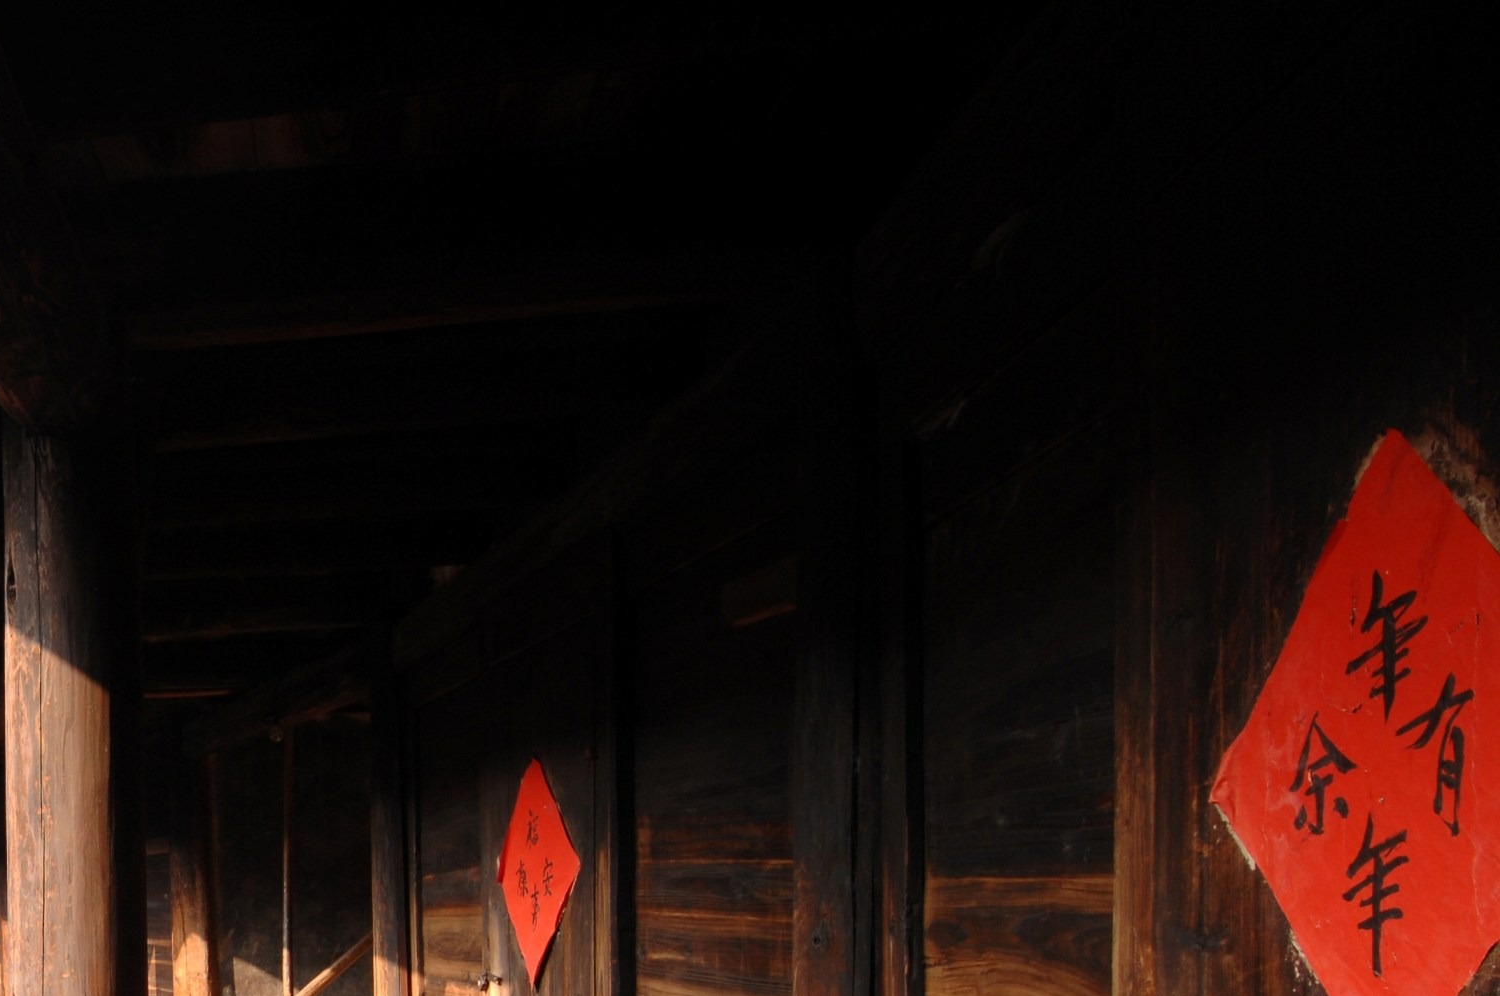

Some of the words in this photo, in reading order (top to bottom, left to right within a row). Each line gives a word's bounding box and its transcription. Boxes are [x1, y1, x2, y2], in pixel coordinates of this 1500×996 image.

[1345, 569, 1428, 722] 年
[1289, 710, 1357, 836] 余
[1396, 673, 1474, 836] 有
[1341, 812, 1409, 978] 年
